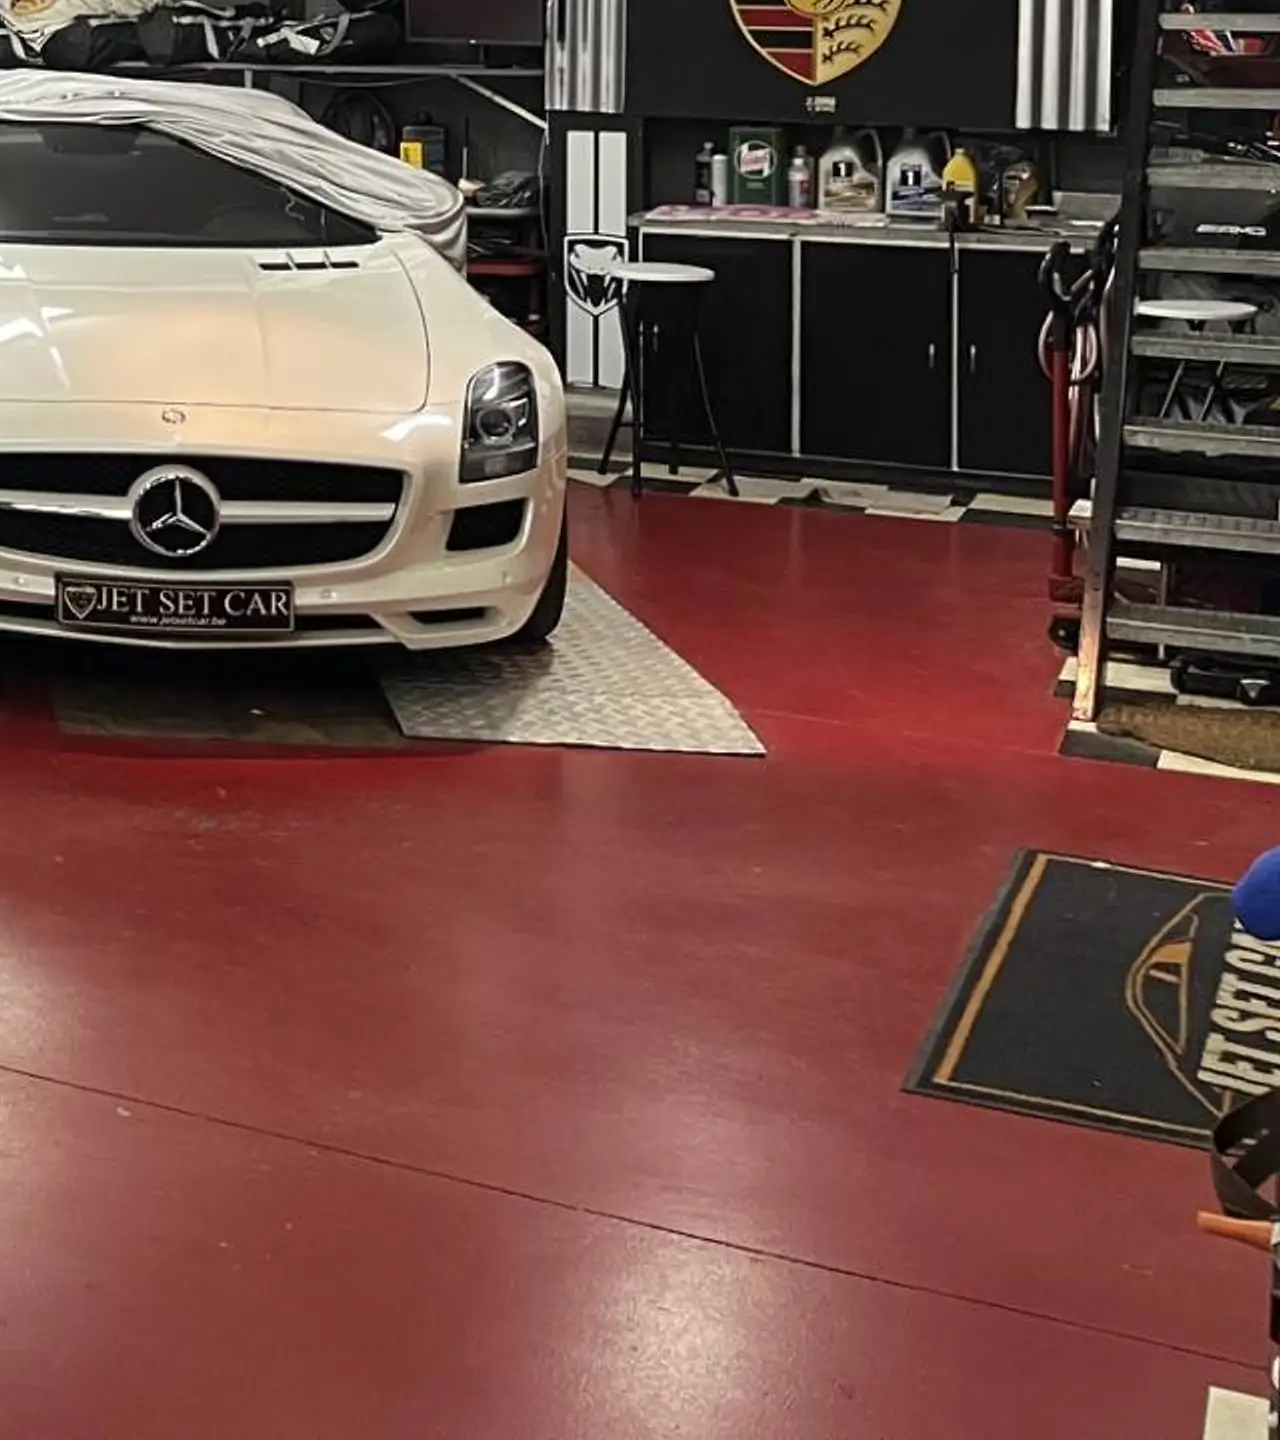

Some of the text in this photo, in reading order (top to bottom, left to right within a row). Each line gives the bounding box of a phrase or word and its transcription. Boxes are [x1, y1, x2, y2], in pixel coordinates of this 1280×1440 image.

[96, 585, 289, 617] JET SET CAR
